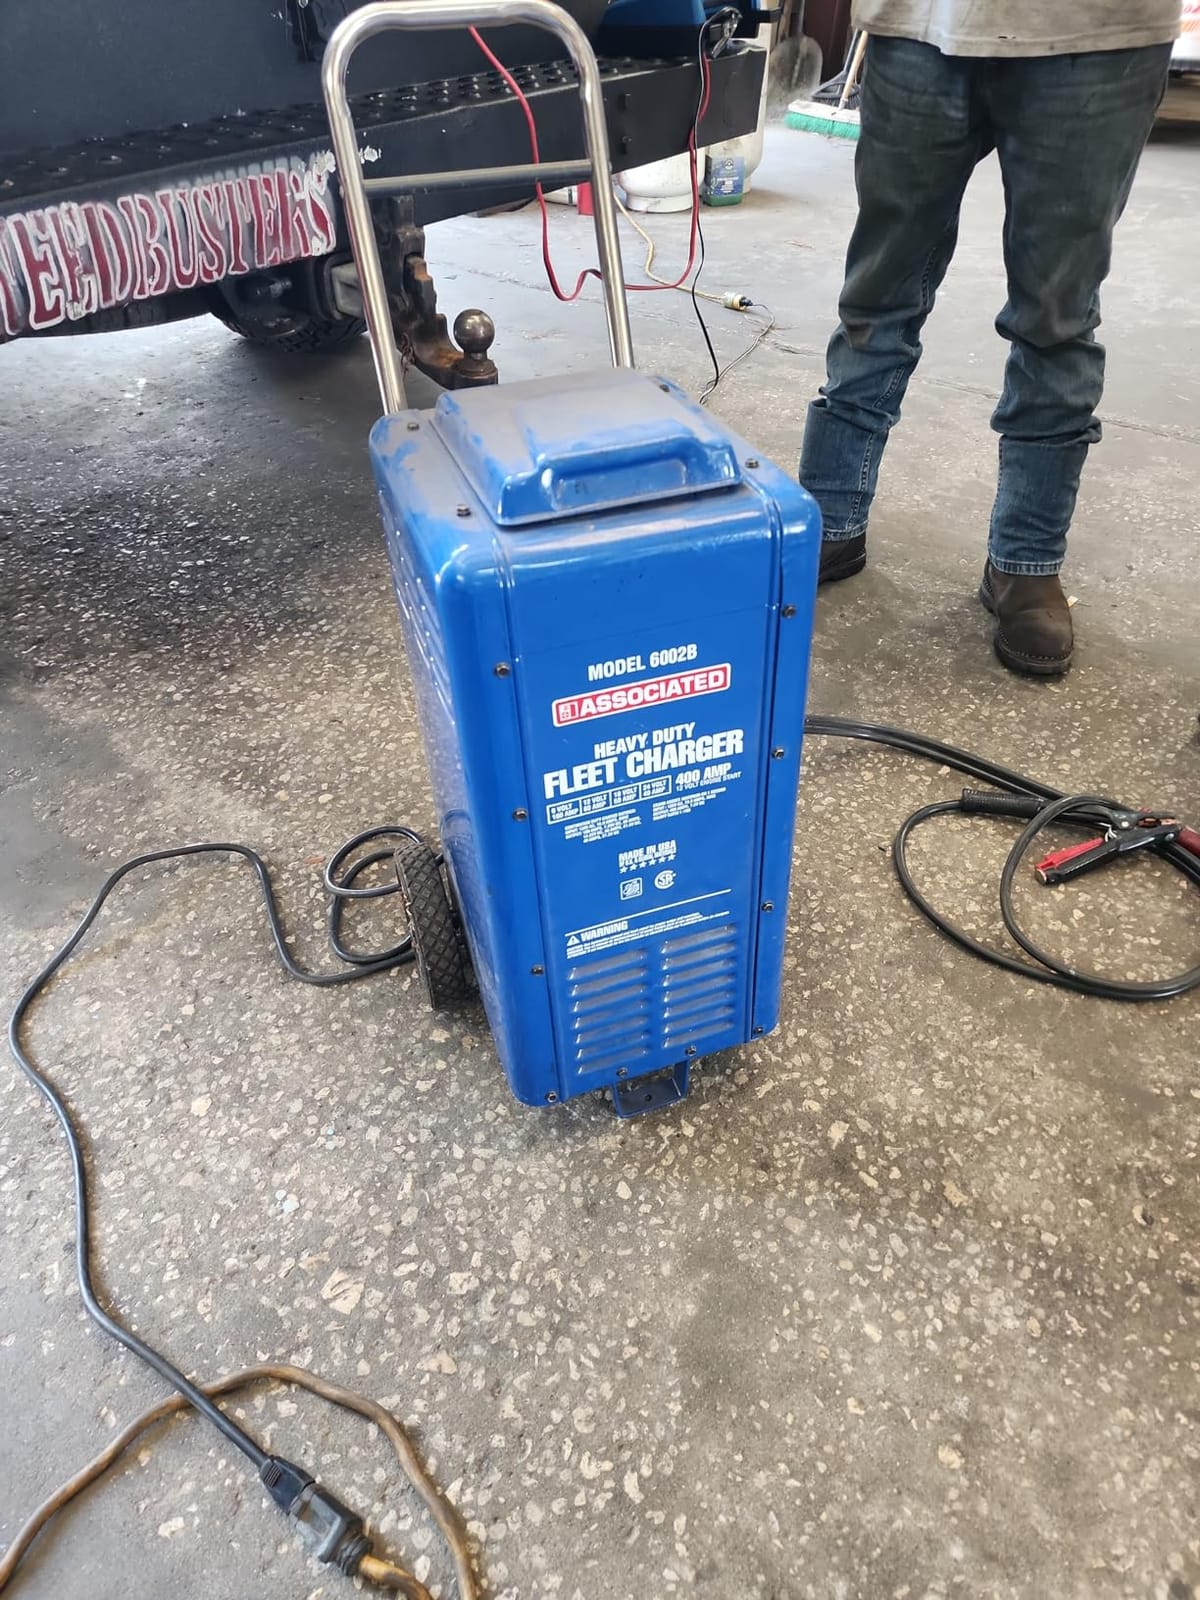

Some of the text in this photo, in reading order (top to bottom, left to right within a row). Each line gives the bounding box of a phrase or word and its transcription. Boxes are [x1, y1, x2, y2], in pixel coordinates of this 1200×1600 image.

[588, 644, 697, 682] MODEL 6002B
[580, 669, 725, 717] ASSOCIATED
[594, 722, 696, 760] HEAVY DUTY
[544, 728, 744, 799] FLEET CHARGER
[675, 762, 732, 785] 400 AMP
[684, 781, 699, 790] VOLT
[556, 802, 572, 812] VOLT
[591, 794, 608, 803] VOLT
[564, 808, 579, 816] AMP
[618, 848, 644, 863] MADE
[581, 920, 628, 942] WARNING
